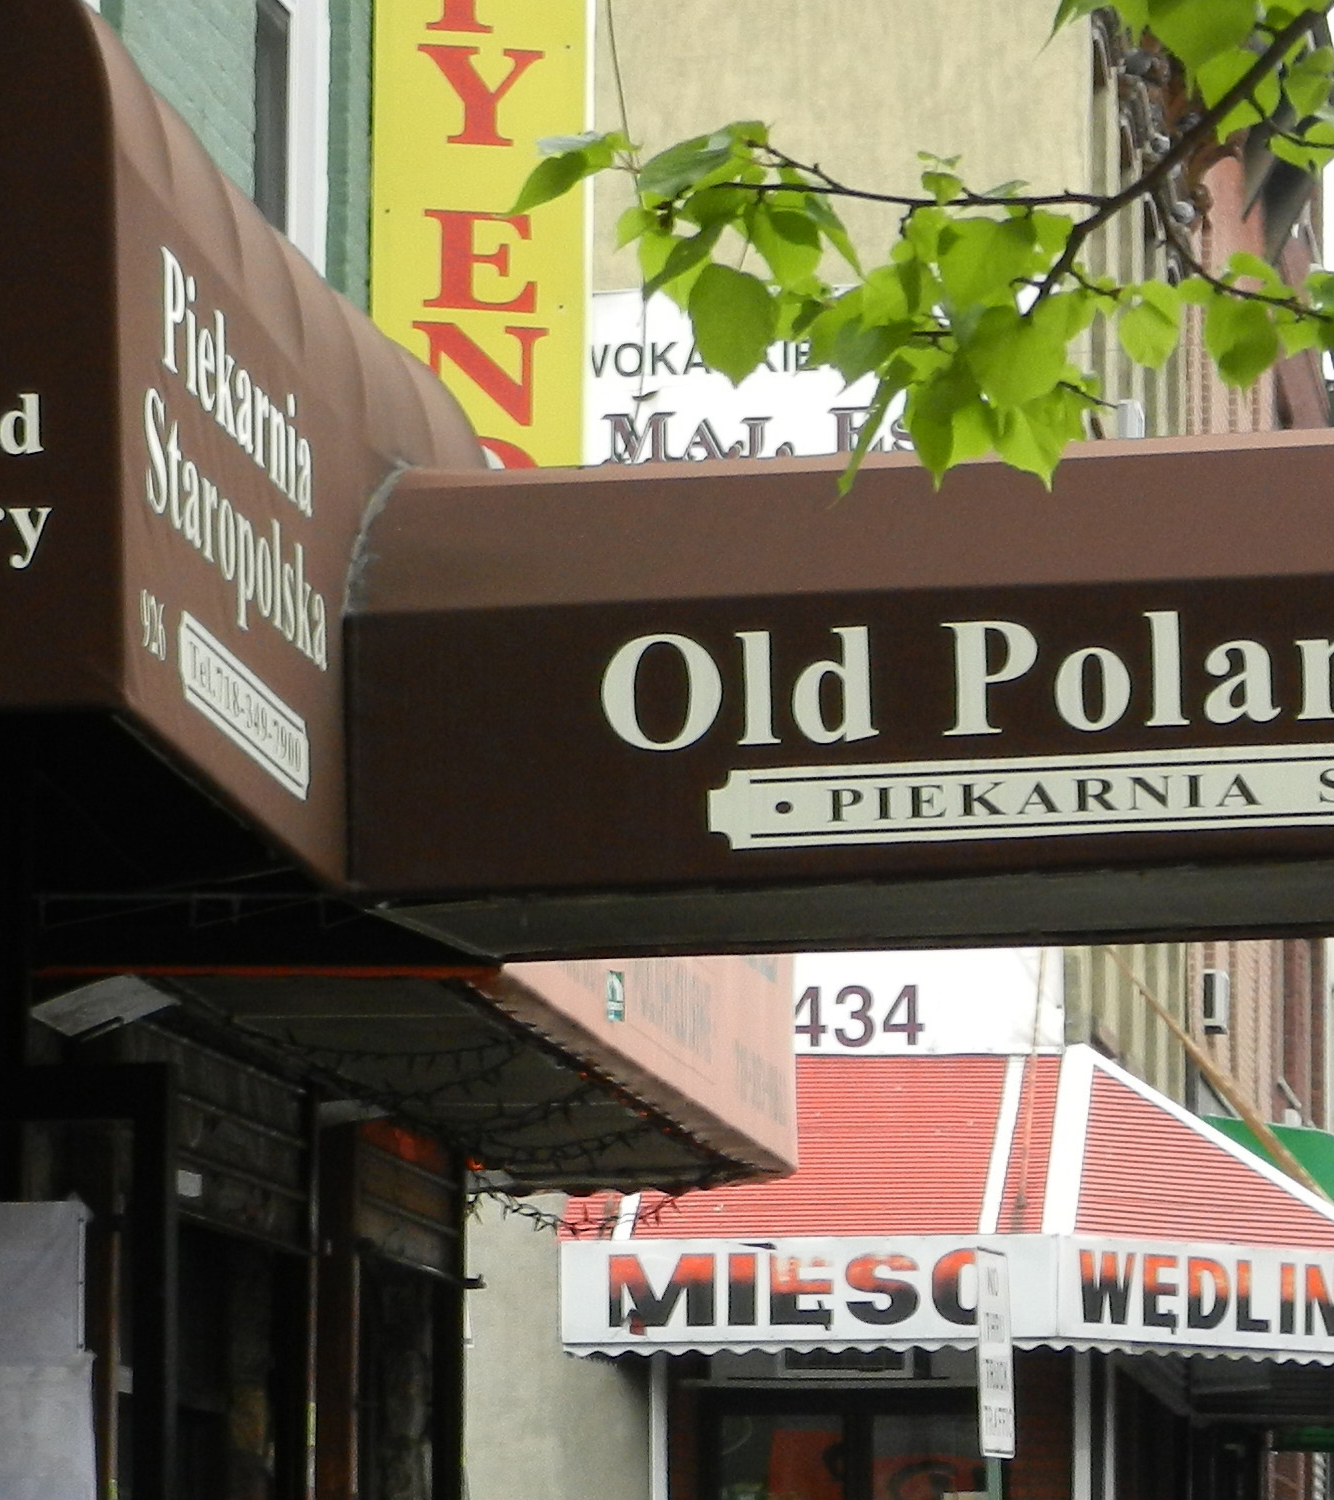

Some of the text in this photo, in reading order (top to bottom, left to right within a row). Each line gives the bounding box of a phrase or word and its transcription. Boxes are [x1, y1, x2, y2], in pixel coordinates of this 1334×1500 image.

[161, 245, 313, 517] Piekarnia
[143, 387, 328, 672] Staropolska
[139, 588, 167, 662] 926
[600, 624, 881, 752] Old
[826, 773, 1264, 824] PIEKARNIA
[794, 984, 925, 1047] 434
